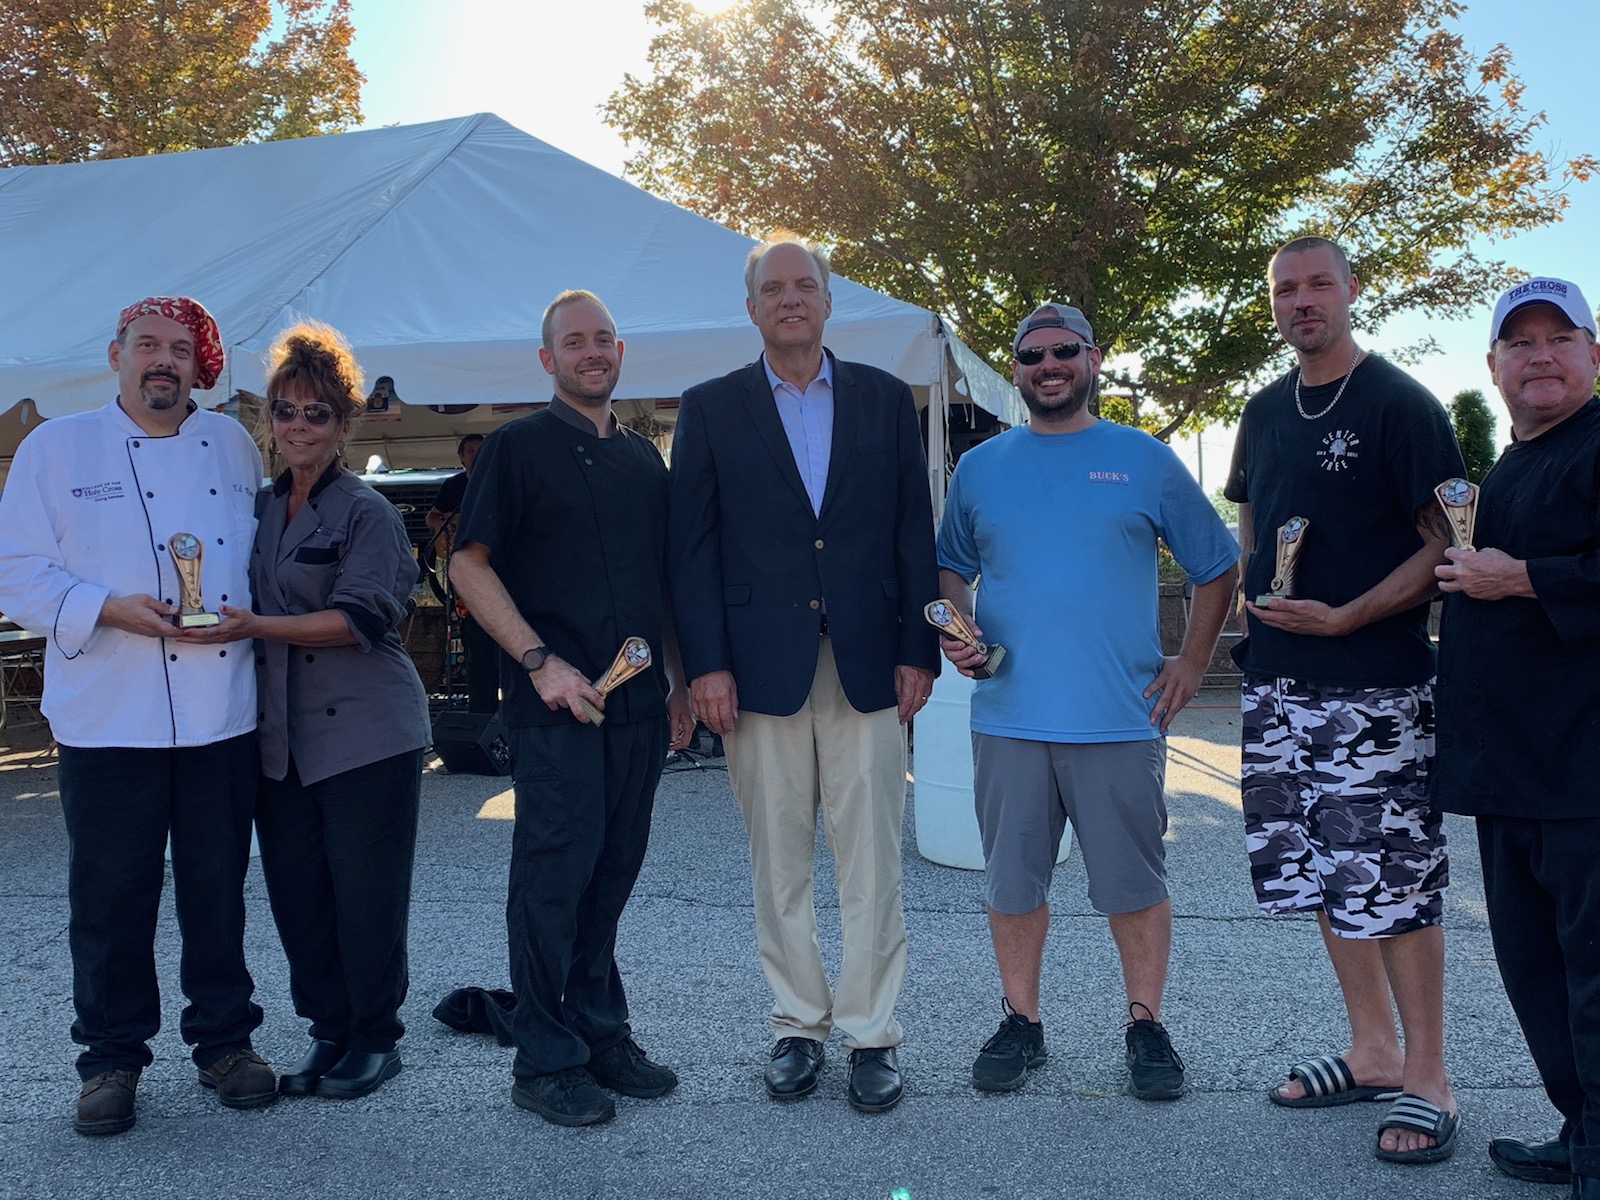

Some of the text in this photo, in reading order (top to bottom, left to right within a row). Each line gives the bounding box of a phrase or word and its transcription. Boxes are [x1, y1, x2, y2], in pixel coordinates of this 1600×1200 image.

[1508, 283, 1530, 300] THE
[1531, 281, 1568, 295] CROSS
[1322, 429, 1360, 447] CENTER
[1320, 458, 1349, 471] TREE
[1089, 471, 1130, 482] BUCK'S
[84, 489, 101, 497] Holy
